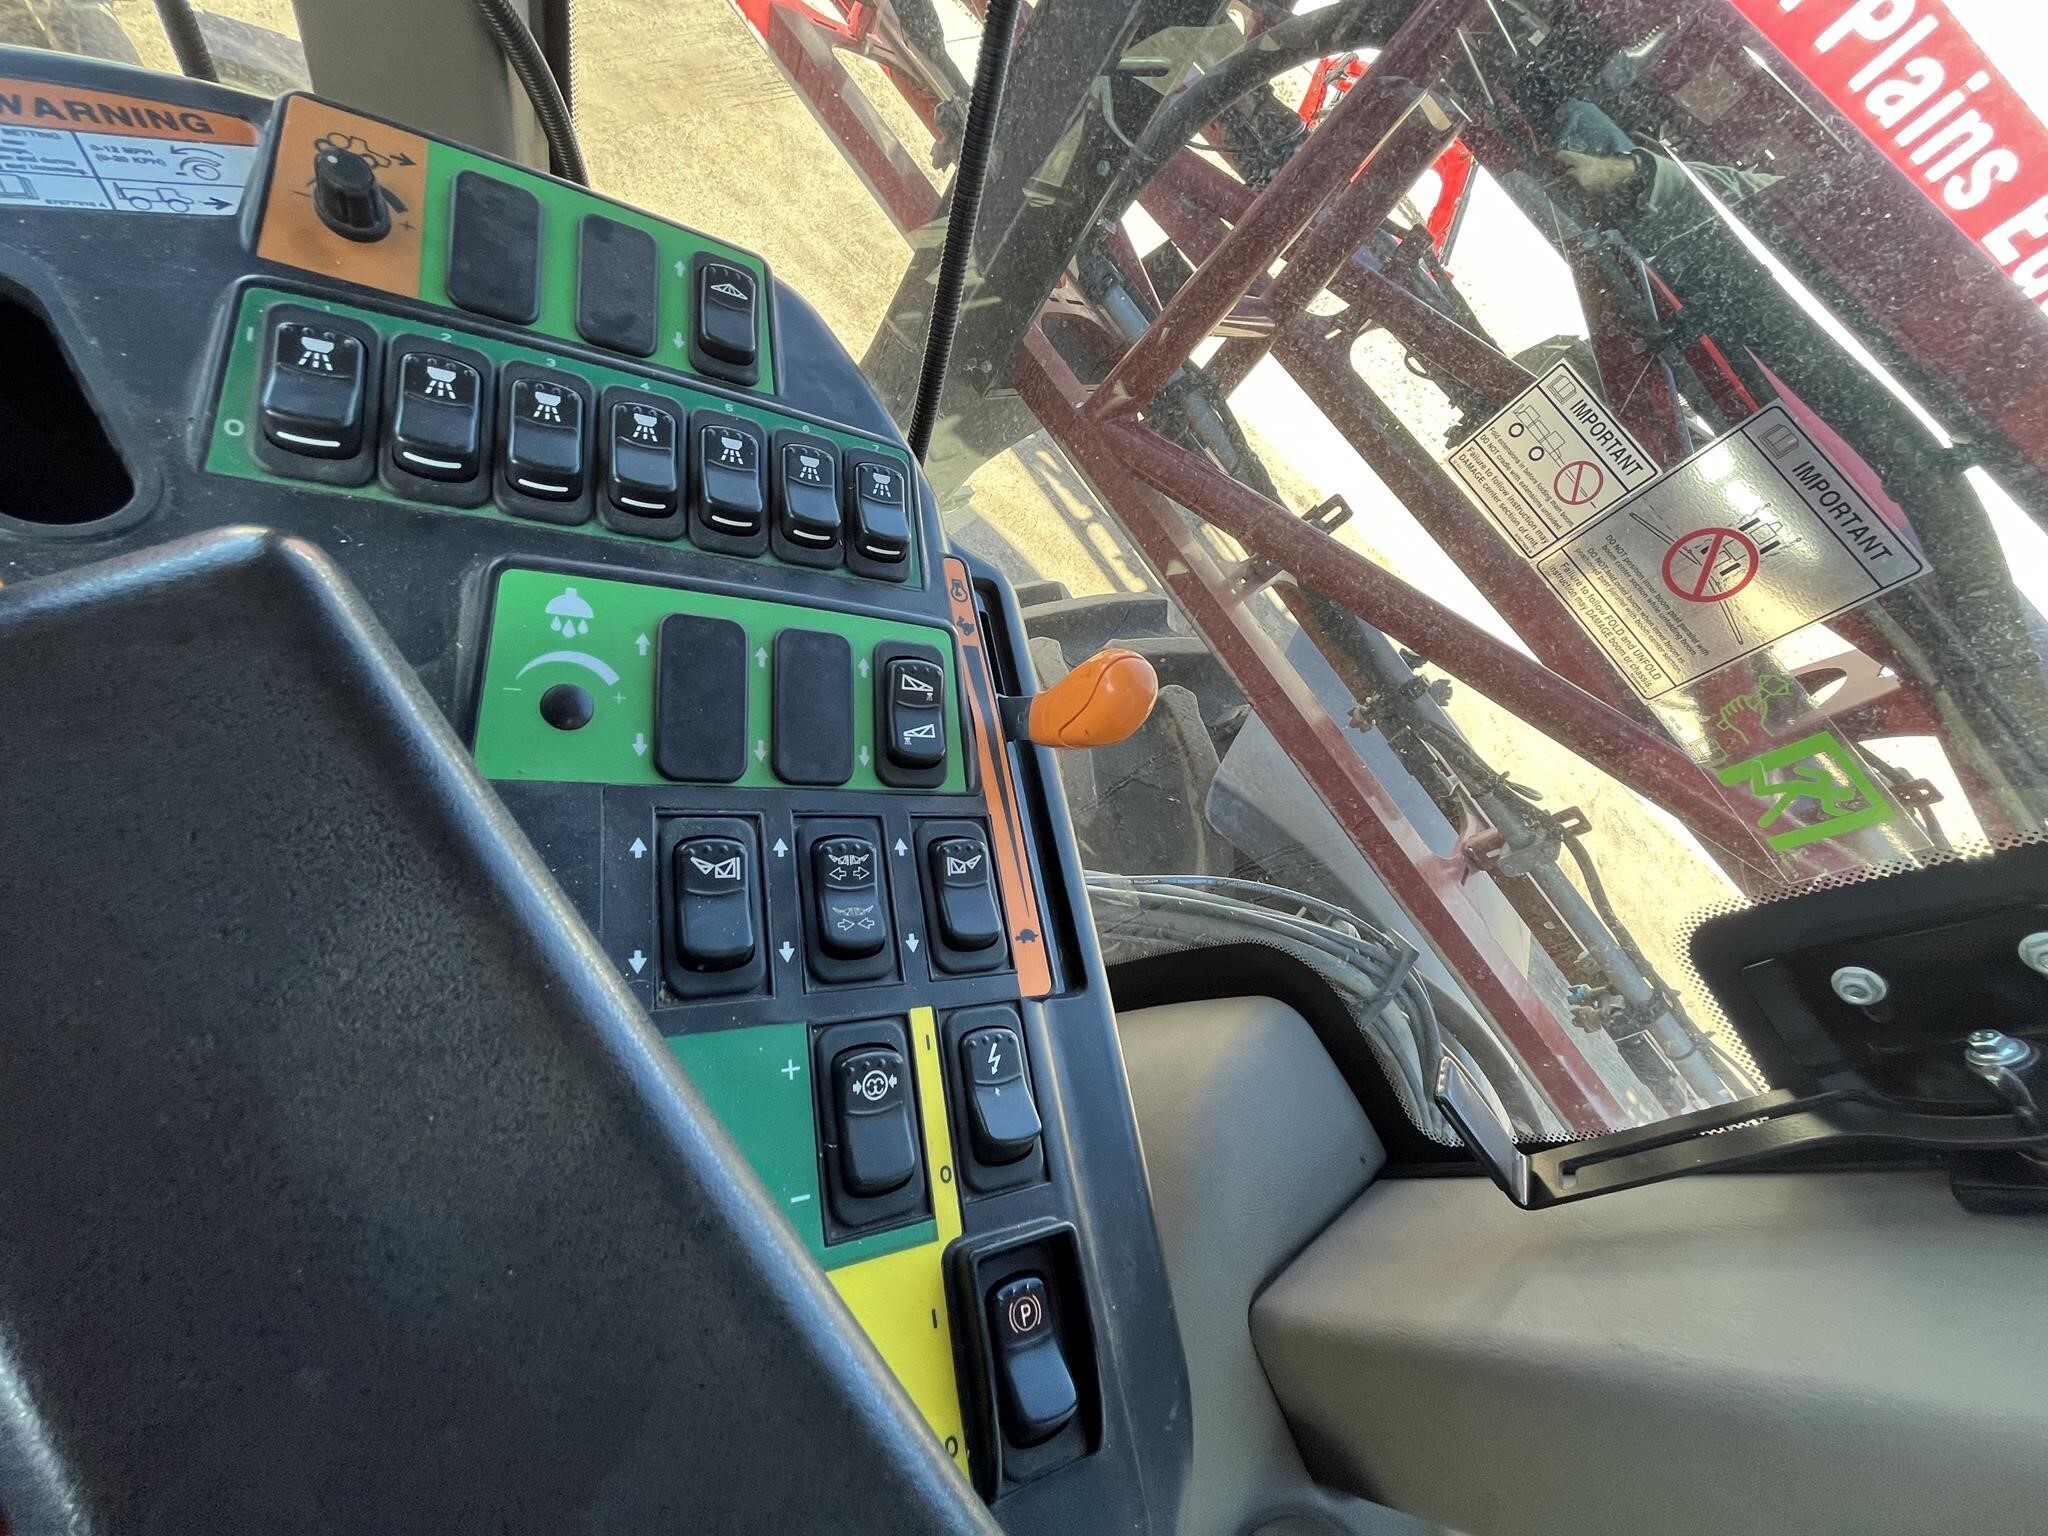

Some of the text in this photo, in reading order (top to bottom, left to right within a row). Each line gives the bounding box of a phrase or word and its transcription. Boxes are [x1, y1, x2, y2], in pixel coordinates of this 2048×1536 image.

[1814, 0, 2019, 210] Plains
[1479, 433, 1490, 444] DO
[1486, 442, 1499, 455] NOT
[1495, 453, 1512, 471] cradle
[1509, 468, 1522, 482] with
[1517, 479, 1543, 508] extensions
[1488, 426, 1500, 439] Fold
[1497, 436, 1522, 464] extensions
[1517, 461, 1526, 469] in
[1522, 467, 1539, 484] before
[1533, 482, 1553, 502] folding
[1549, 498, 1564, 513] main
[1569, 398, 1644, 478] IMPORTANT
[1458, 453, 1485, 484] DAMAGE
[1481, 481, 1502, 503] center
[1498, 501, 1521, 527] section
[1517, 524, 1527, 534] of
[1523, 532, 1540, 549] unit.
[1466, 446, 1488, 470] Failure
[1484, 467, 1494, 477] to
[1490, 475, 1511, 497] follow
[1506, 494, 1539, 530] instruction
[1533, 529, 1549, 545] may
[1790, 460, 1893, 564] IMPORTANT
[1548, 563, 1579, 597] instruction
[1572, 596, 1588, 611] may
[1584, 608, 1613, 638] DAMAGE
[1607, 636, 1628, 656] boom
[1622, 656, 1632, 664] or
[1628, 662, 1655, 689] chassis.
[1560, 561, 1584, 586] Failure
[1579, 585, 1591, 594] to
[1586, 593, 1609, 616] follow
[1603, 614, 1625, 636] FOLD
[1620, 634, 1637, 650] and
[1632, 649, 1662, 680] UNFOLD
[1586, 547, 1598, 558] DO
[1594, 556, 1609, 571] NOT
[1604, 569, 1617, 581] fold
[1613, 579, 1629, 595] outer
[1625, 594, 1643, 612] boom
[1663, 640, 1681, 657] boom
[1596, 574, 1611, 589] past
[1606, 586, 1628, 608] parallel
[1624, 606, 1638, 619] with
[1634, 618, 1651, 635] boom
[1647, 634, 1665, 652] center
[1601, 544, 1618, 561] boom
[1614, 559, 1632, 578] center
[1628, 577, 1649, 598] section
[1645, 597, 1662, 613] while
[1656, 612, 1684, 640] unfolding
[1604, 534, 1710, 656] DO NOT position inner boom past parallel with
